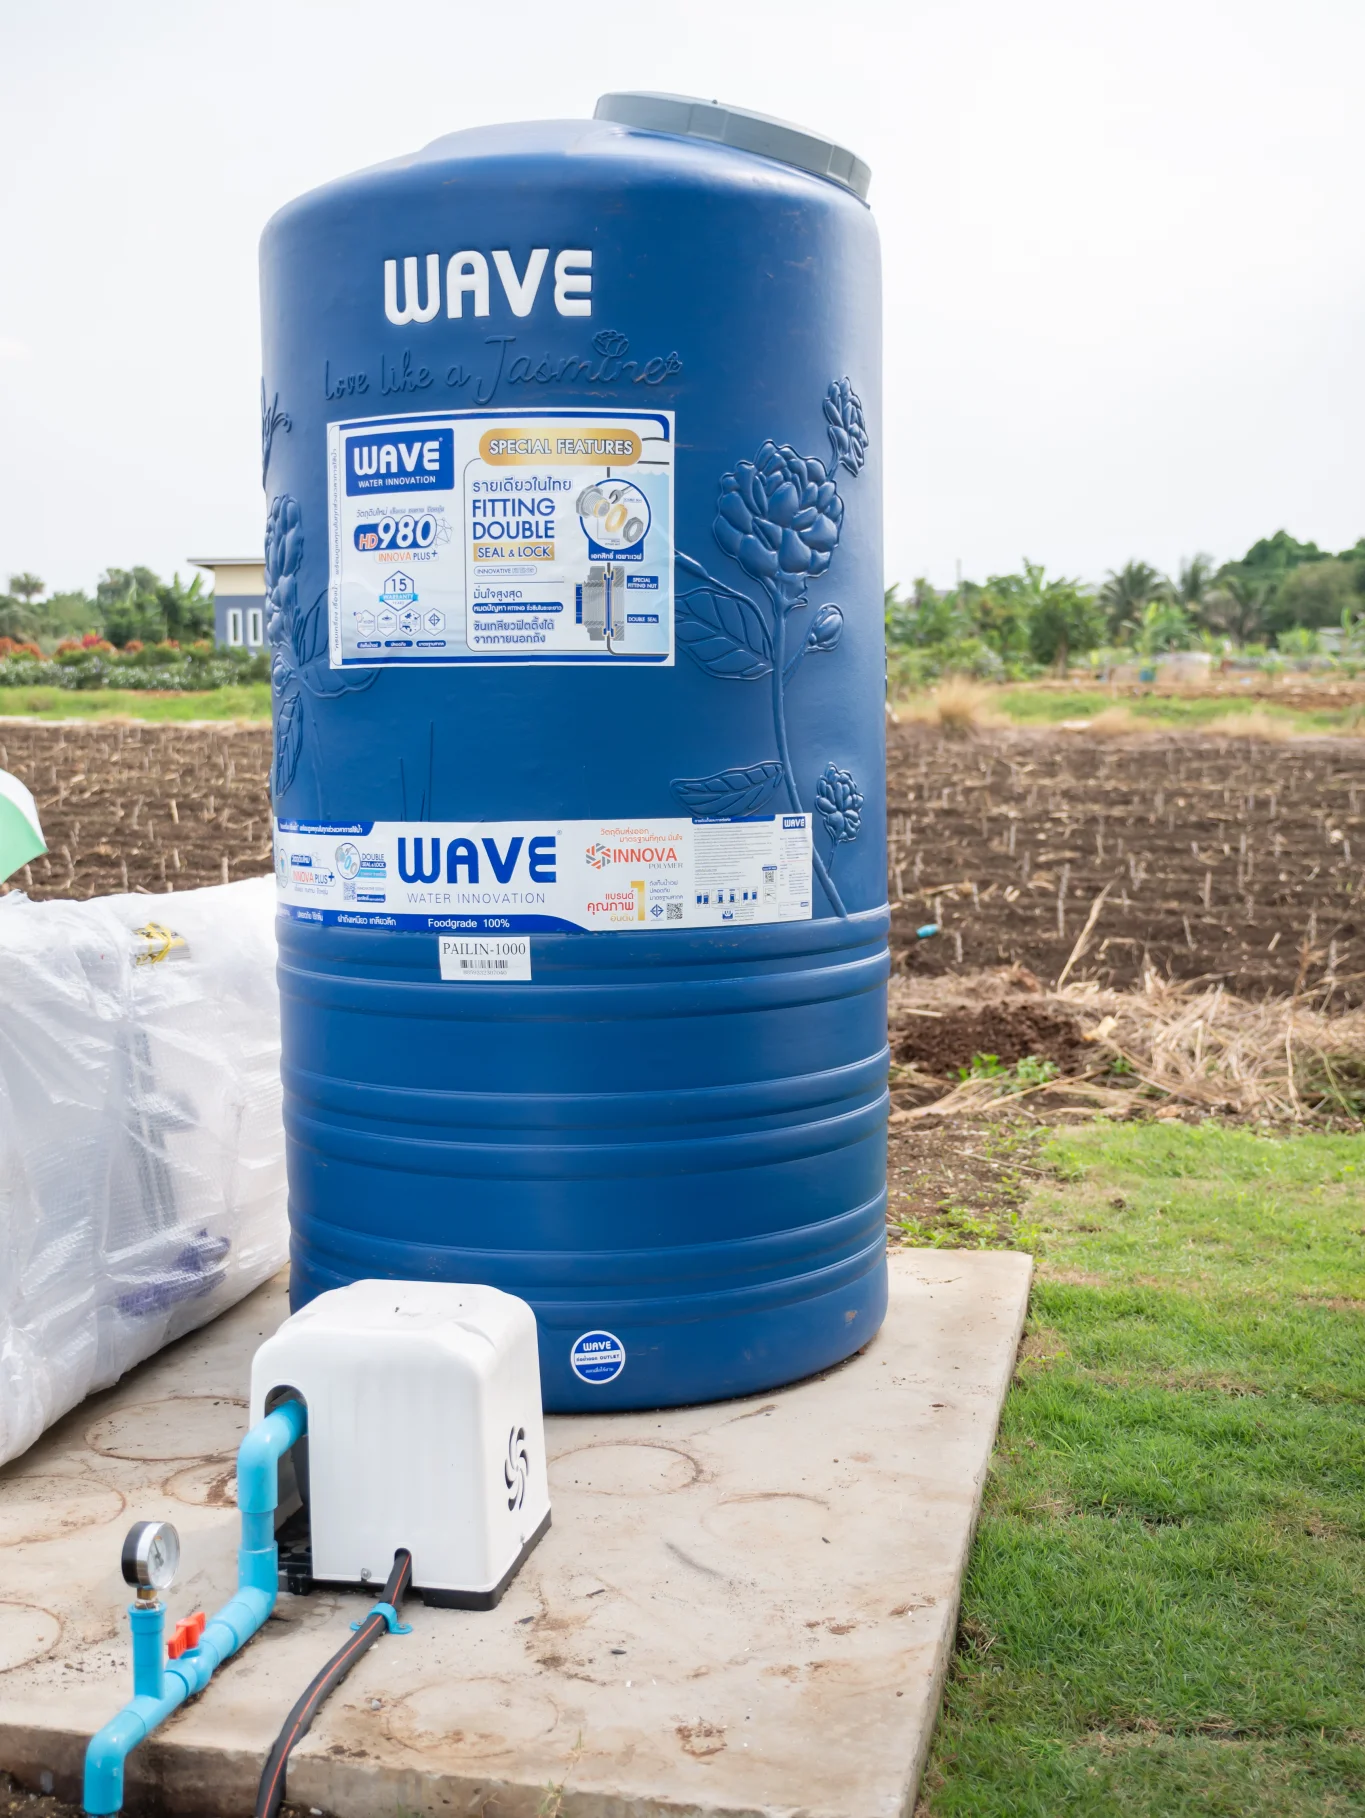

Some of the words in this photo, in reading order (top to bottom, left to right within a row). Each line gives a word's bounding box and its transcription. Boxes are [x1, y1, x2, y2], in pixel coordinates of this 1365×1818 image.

[384, 248, 593, 325] WAVE
[324, 358, 370, 401] Love
[380, 347, 434, 397] like
[446, 363, 471, 388] a
[473, 332, 681, 405] Jasmine
[488, 438, 552, 455] SPECIAL
[556, 438, 634, 455] FEATURES
[353, 441, 440, 476] WAVE
[358, 479, 384, 488] WATER
[385, 476, 436, 486] INNOVATION
[472, 476, 572, 493] รายเดียวในไทย
[472, 497, 556, 518] FITTING
[472, 520, 556, 540] DOUBLE
[378, 552, 412, 562] INNOVA
[477, 547, 506, 559] SEAL
[517, 546, 551, 558] LOCK
[391, 579, 407, 592] 15
[473, 585, 523, 602] มั่นใจสูงสุด
[473, 632, 547, 644] จากภายนอกถัง
[784, 818, 805, 828] WAVE
[362, 853, 385, 861] DOUBLE
[397, 836, 557, 884] WAVE
[613, 847, 678, 863] INNOVA
[406, 892, 451, 904] WATER
[457, 892, 546, 904] INNOVATION
[605, 889, 634, 900] แบรนด์
[631, 880, 645, 921] 1
[587, 901, 634, 915] คุณภาพ
[428, 918, 478, 929] Foodgrade
[483, 918, 510, 928] 100%
[442, 942, 527, 955] PAILIN-1000
[582, 1341, 612, 1351] WAVE
